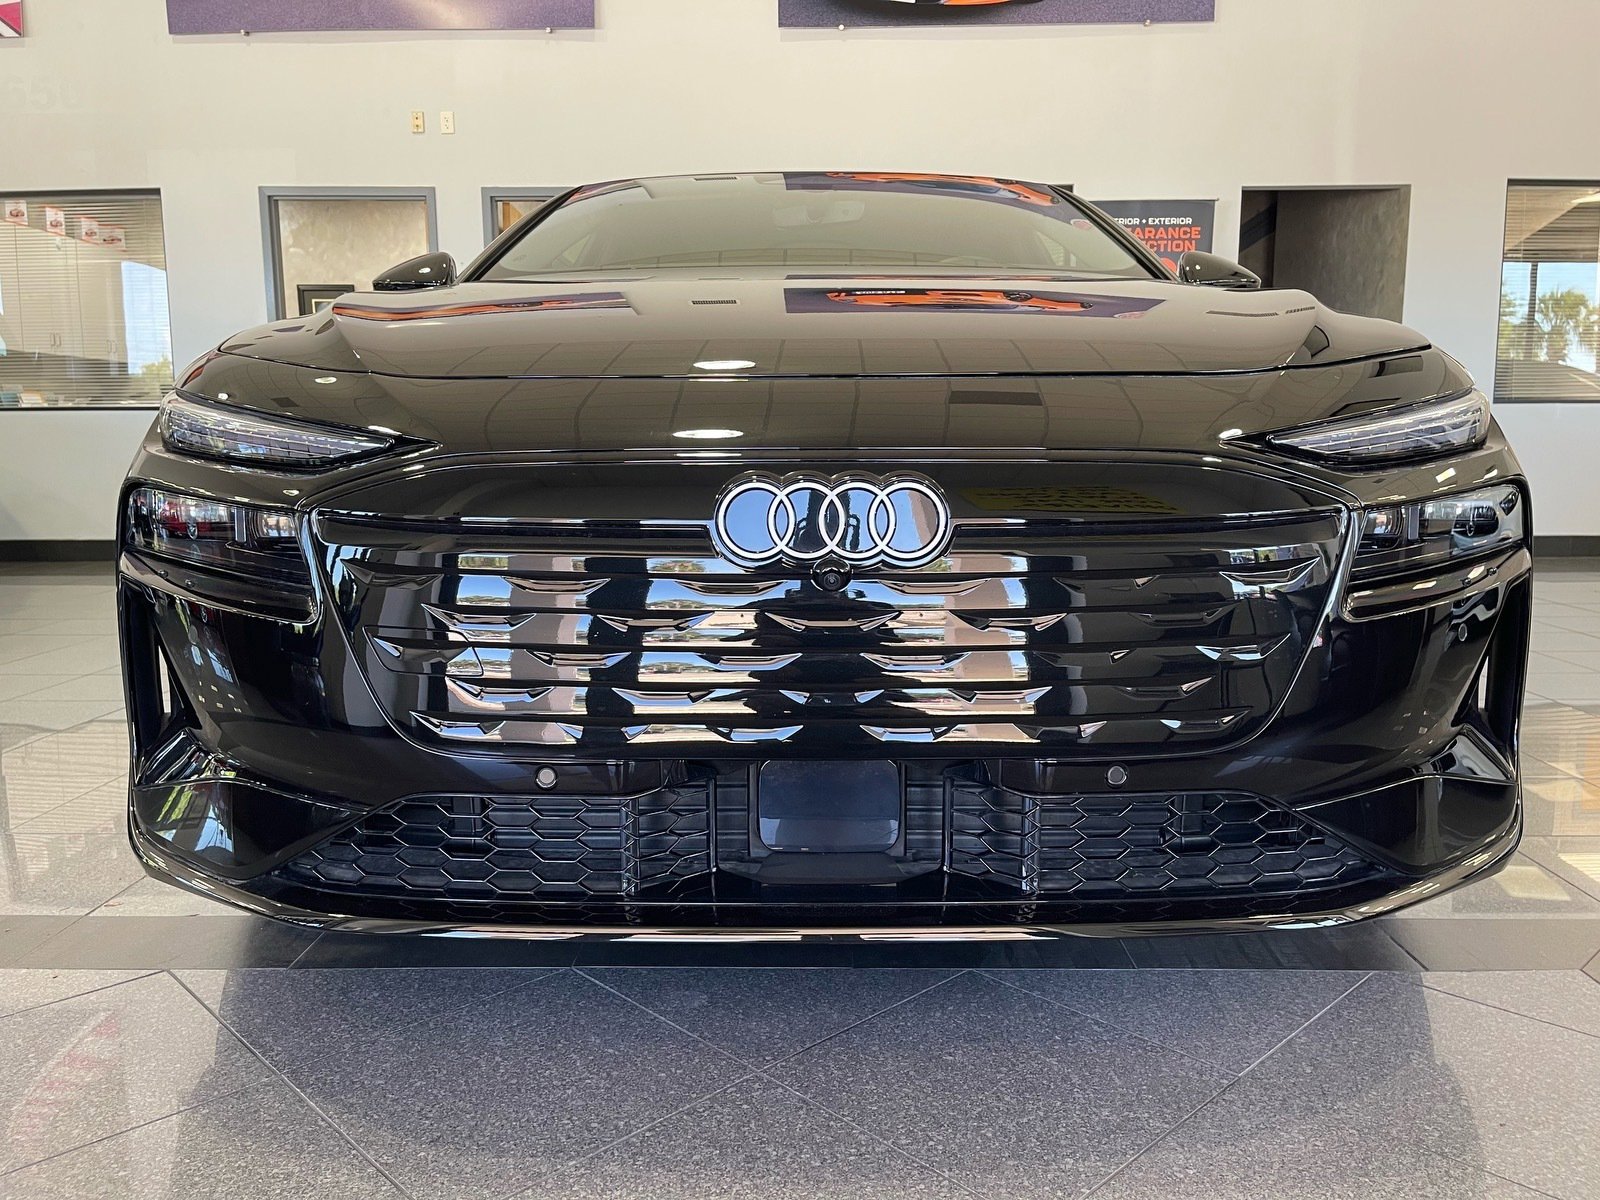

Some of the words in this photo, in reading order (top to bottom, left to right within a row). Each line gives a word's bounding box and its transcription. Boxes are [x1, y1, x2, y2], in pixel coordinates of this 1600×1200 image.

[1148, 217, 1193, 225] EXTERIOR
[1127, 227, 1201, 239] ARANCE
[1142, 240, 1196, 252] CTION
